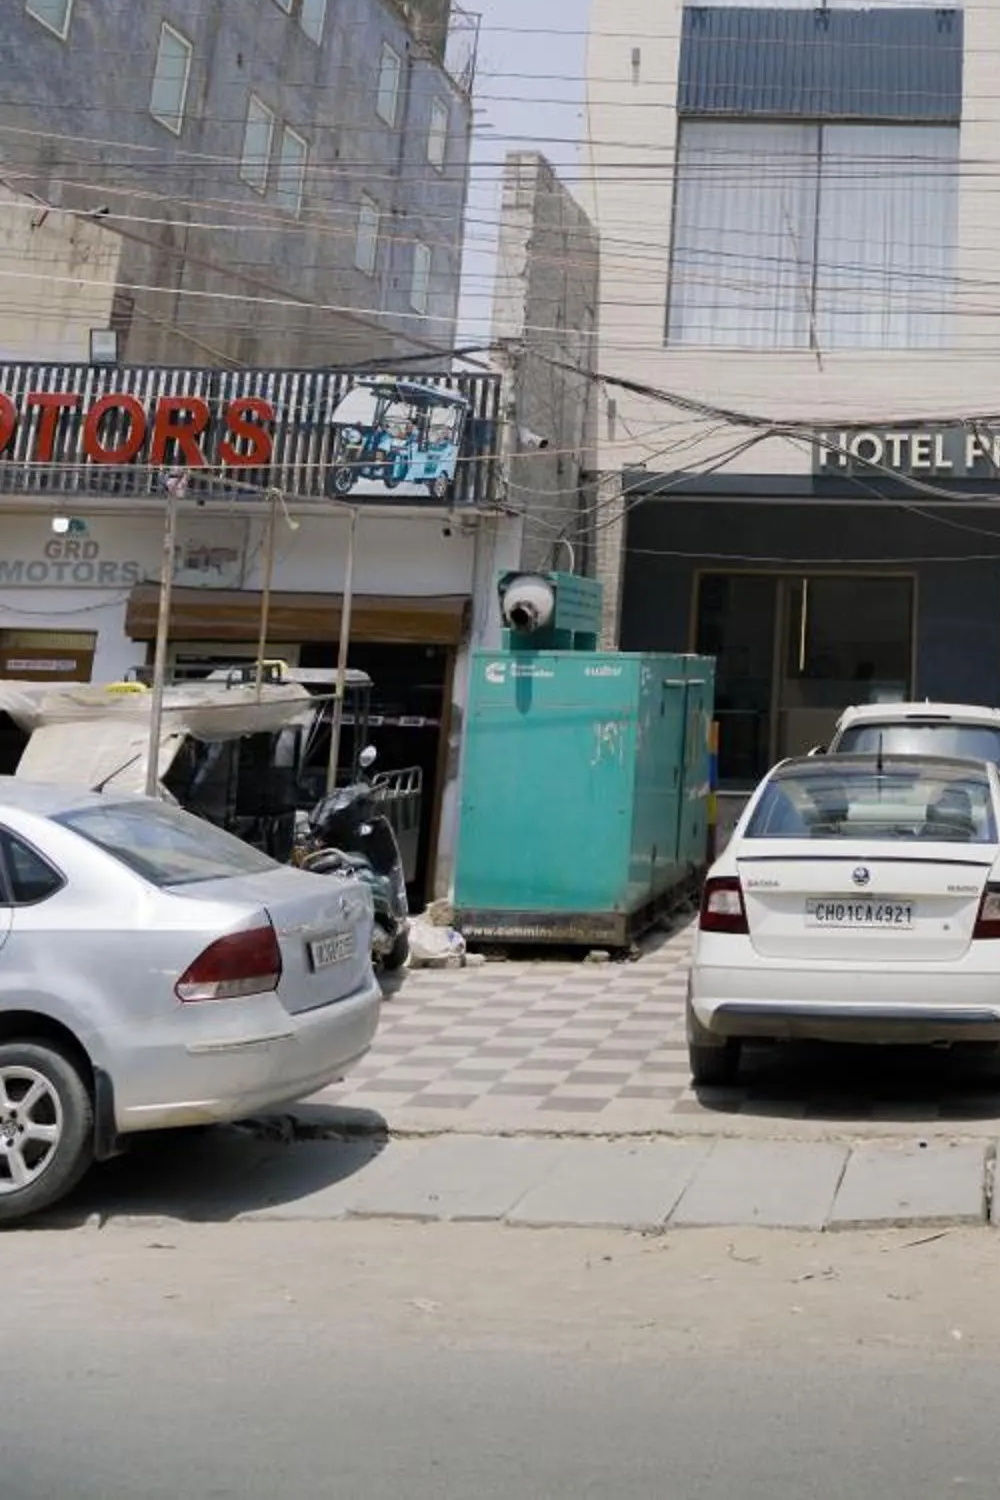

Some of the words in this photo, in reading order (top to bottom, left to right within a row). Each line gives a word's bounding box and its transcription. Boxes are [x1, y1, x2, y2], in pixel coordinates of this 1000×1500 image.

[0, 391, 274, 466] TORS
[818, 433, 953, 468] HOTEL
[45, 540, 99, 560] GRD
[0, 561, 140, 582] MOTORS
[815, 904, 912, 923] CH01CA4921
